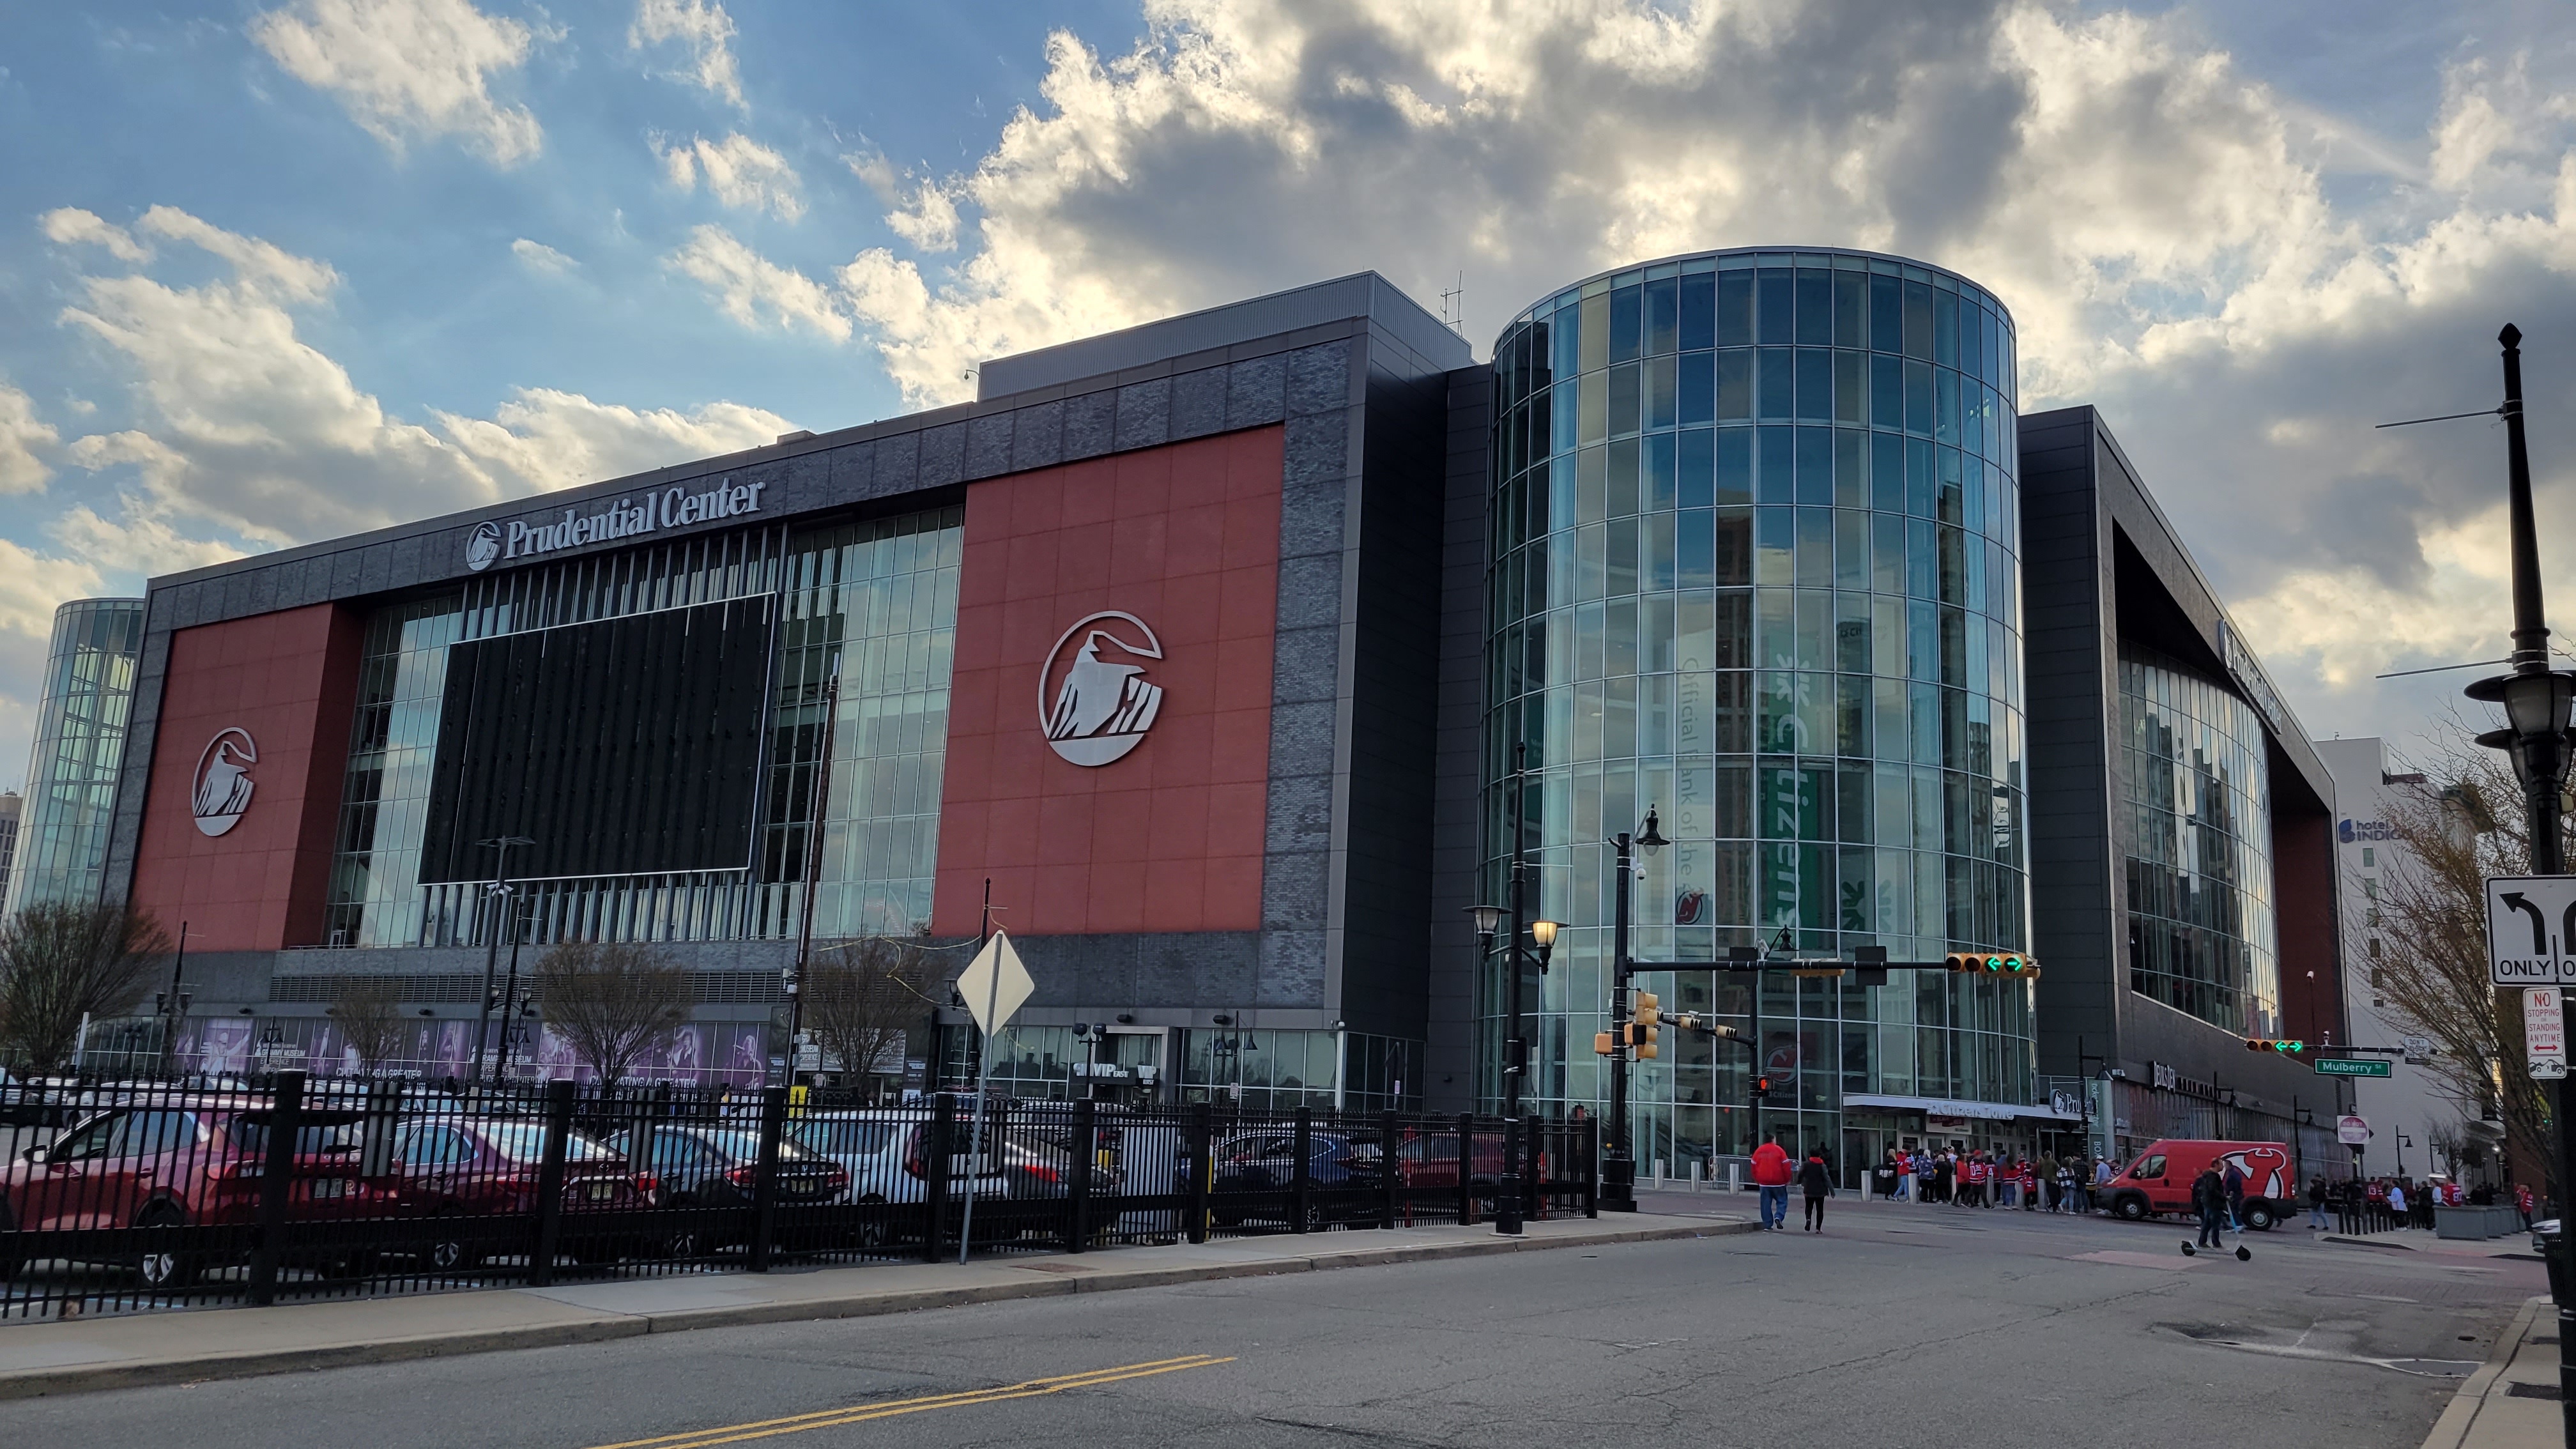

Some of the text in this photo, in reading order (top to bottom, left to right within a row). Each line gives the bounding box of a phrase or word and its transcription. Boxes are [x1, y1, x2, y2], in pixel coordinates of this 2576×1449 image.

[503, 478, 765, 560] Prudential Center
[2232, 633, 2283, 735] Prudential Center
[1681, 657, 1698, 743] Official
[1681, 811, 1698, 832] of
[2356, 820, 2389, 831] hotel
[1681, 841, 1698, 876] the
[2500, 960, 2550, 976] ONLY
[2534, 992, 2550, 1008] NO
[2527, 1008, 2559, 1018] STOPPING
[2529, 1023, 2560, 1032] STANDING
[2529, 1033, 2561, 1043] ANYTIME
[1094, 1063, 1116, 1077] VIP
[1137, 1064, 1157, 1079] VIP
[2322, 1062, 2372, 1075] Mulberry
[654, 1077, 698, 1088] GATER
